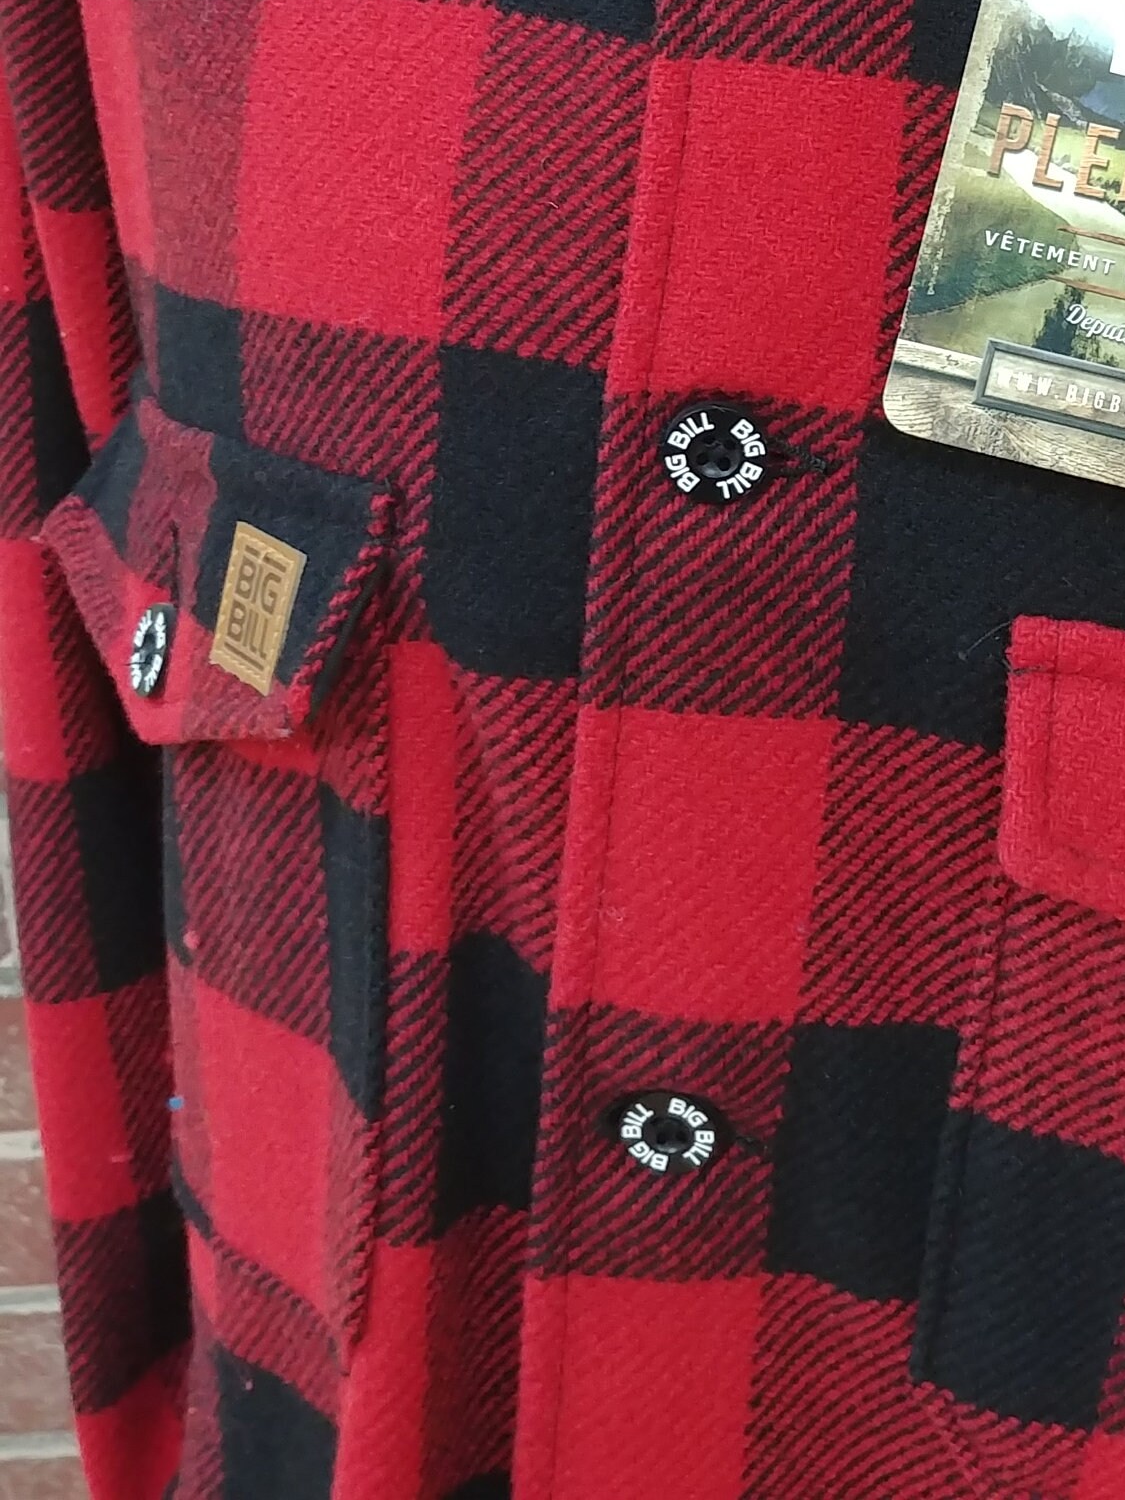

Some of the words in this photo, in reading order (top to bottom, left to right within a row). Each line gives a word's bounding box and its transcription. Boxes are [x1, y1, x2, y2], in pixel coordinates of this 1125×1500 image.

[984, 230, 1117, 276] VÊTEMENT
[667, 412, 715, 450] BILL
[730, 418, 766, 457] BIG
[665, 453, 700, 492] BIG
[716, 461, 763, 499] BILL
[235, 555, 282, 615] BIG
[227, 601, 269, 660] BILL
[621, 1103, 654, 1139] BILL
[668, 1098, 708, 1128] BIG
[628, 1141, 669, 1172] BIG
[682, 1130, 715, 1166] BILL
